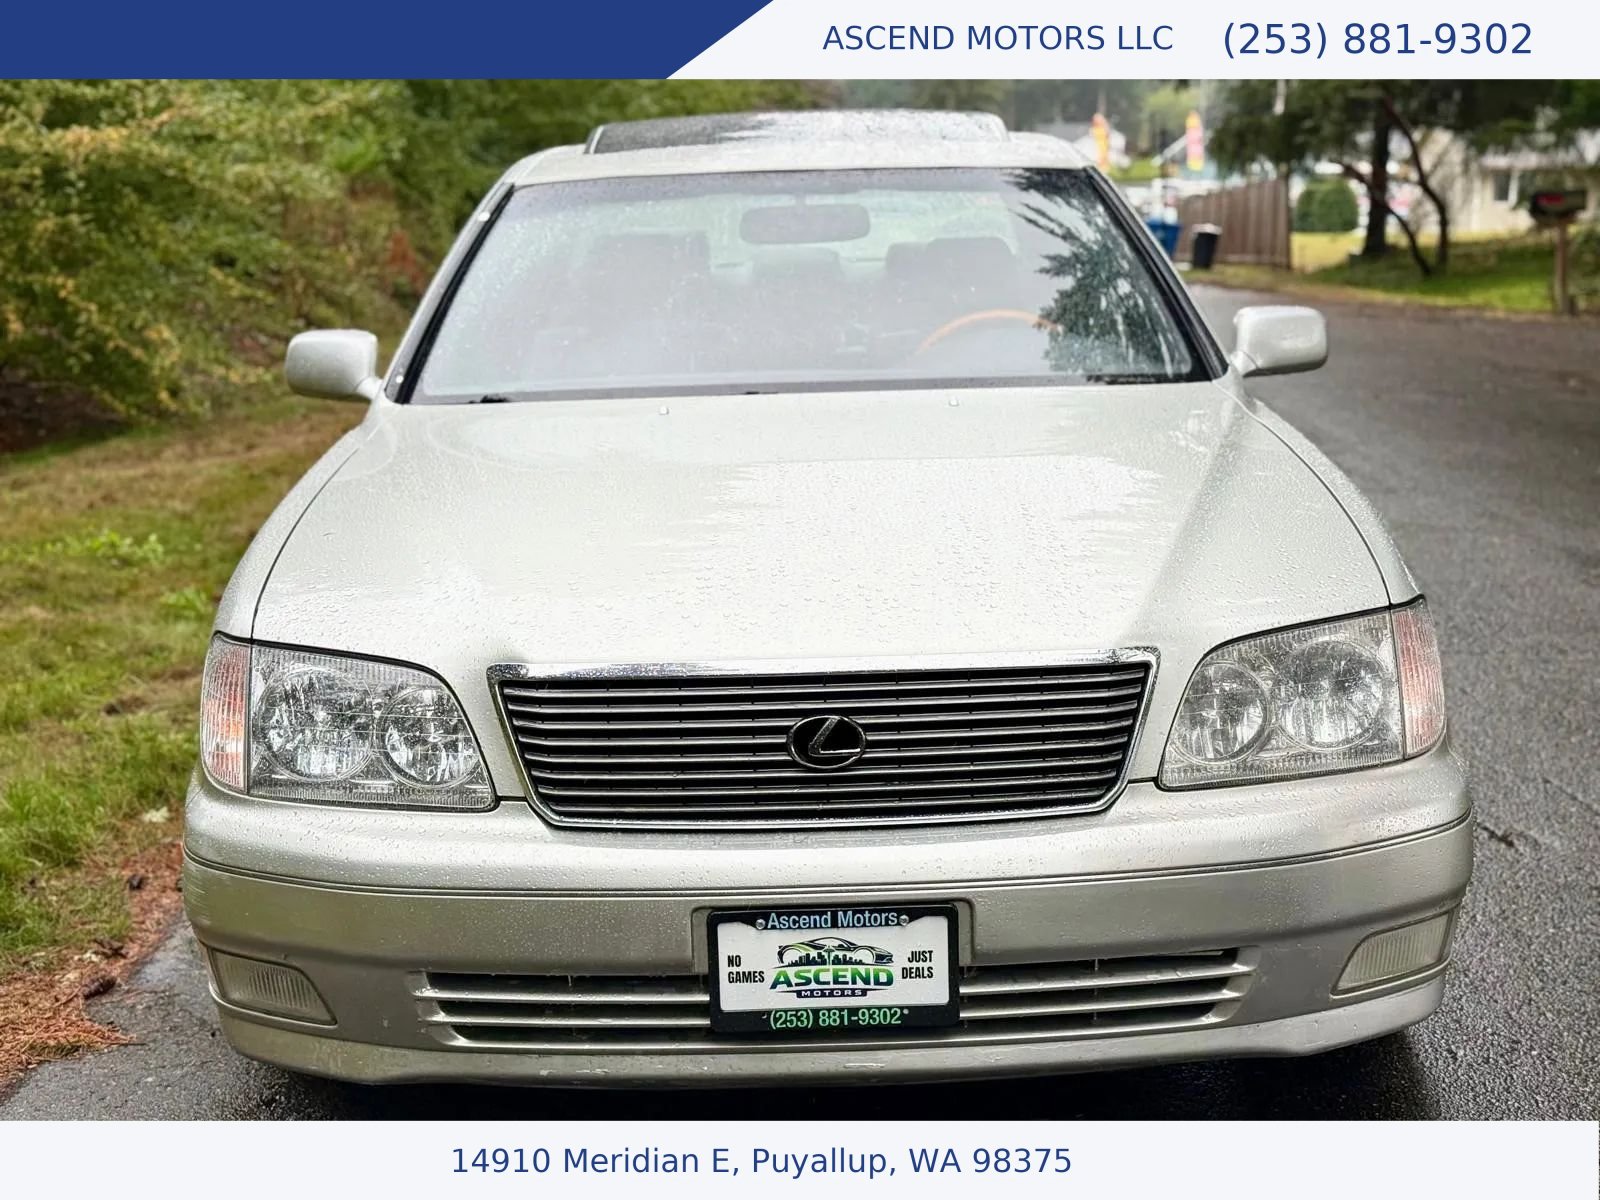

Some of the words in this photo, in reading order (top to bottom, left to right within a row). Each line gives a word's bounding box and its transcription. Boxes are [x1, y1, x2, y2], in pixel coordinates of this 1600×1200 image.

[767, 911, 832, 929] Ascend
[837, 911, 898, 928] Motors
[727, 955, 742, 968] NO
[907, 950, 934, 964] JUST
[727, 971, 765, 984] GAMES
[769, 967, 894, 990] ASCEND
[901, 966, 934, 980] DEALS
[801, 989, 863, 998] MOTORS
[769, 1009, 813, 1030] (253)
[818, 1008, 902, 1026] 881-9302
